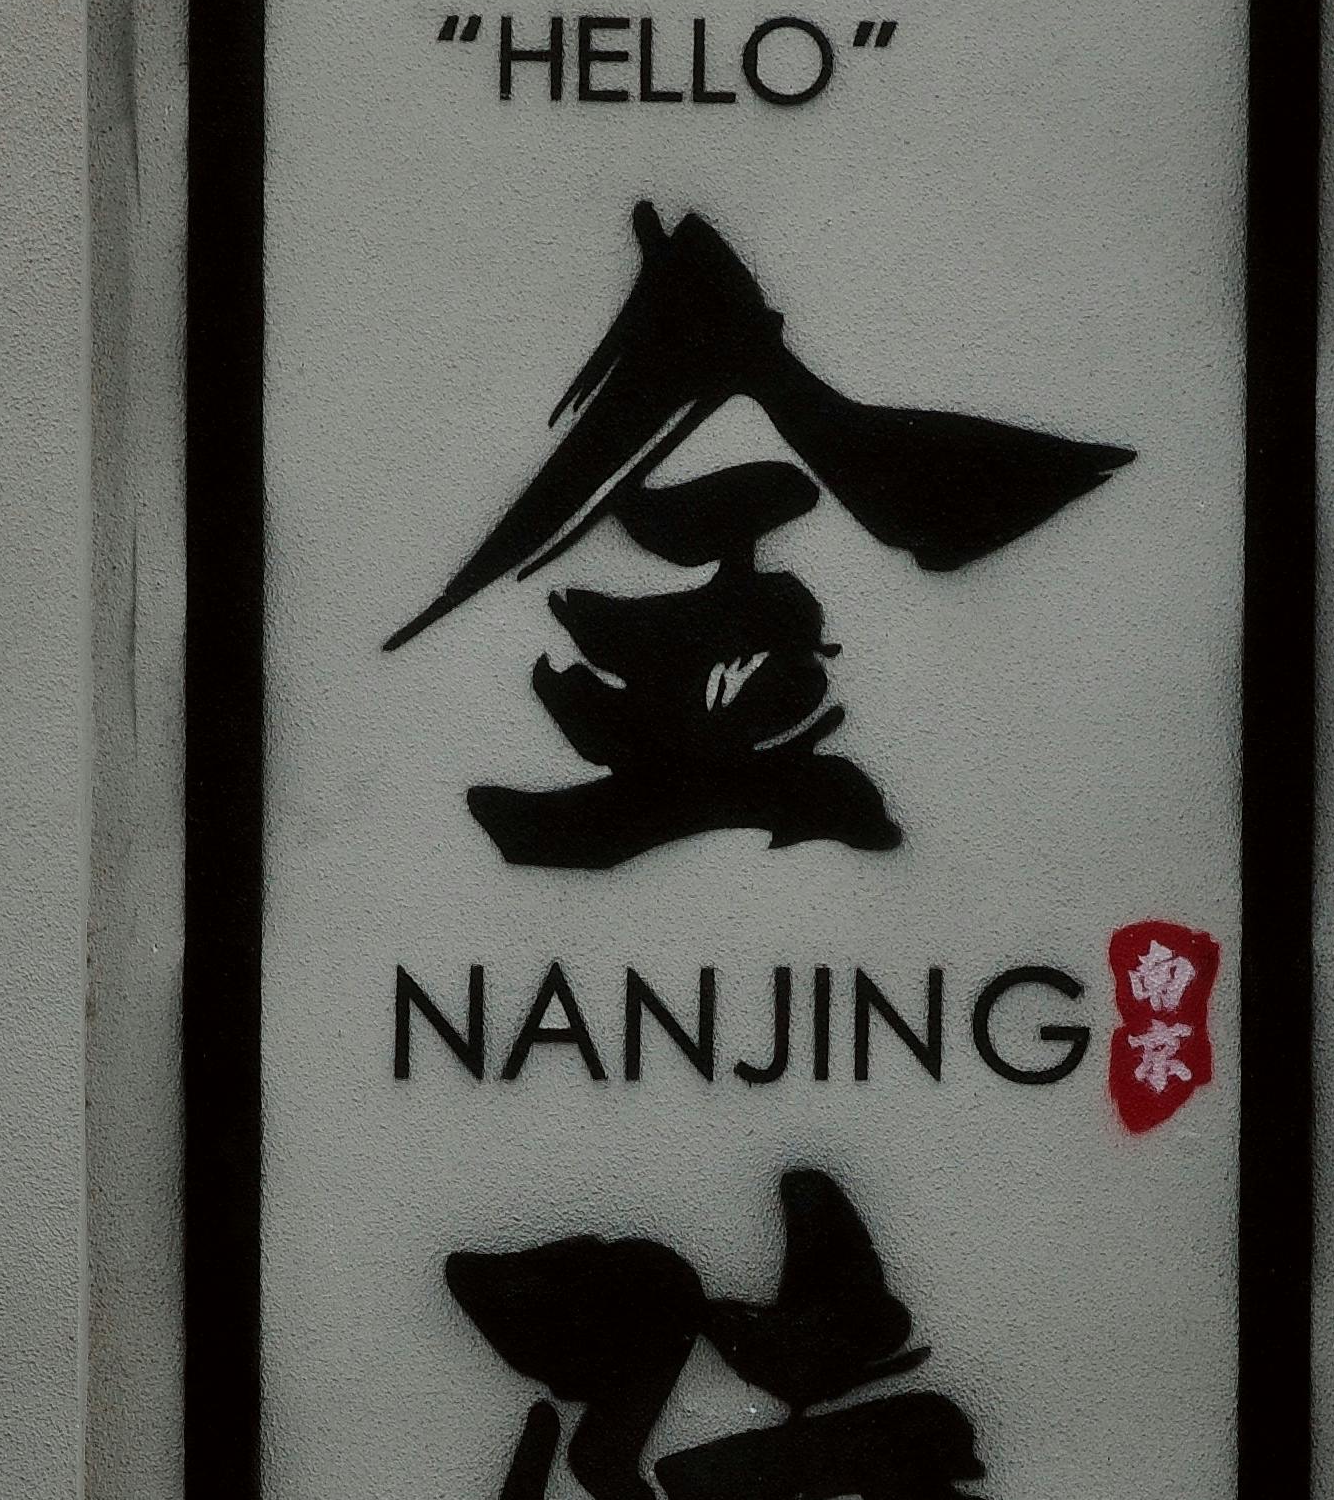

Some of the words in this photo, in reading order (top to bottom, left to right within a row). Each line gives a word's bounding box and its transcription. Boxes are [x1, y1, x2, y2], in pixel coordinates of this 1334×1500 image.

[381, 199, 1138, 870] 金
[393, 962, 1092, 1085] NANJING
[1128, 939, 1196, 1093] 南京
